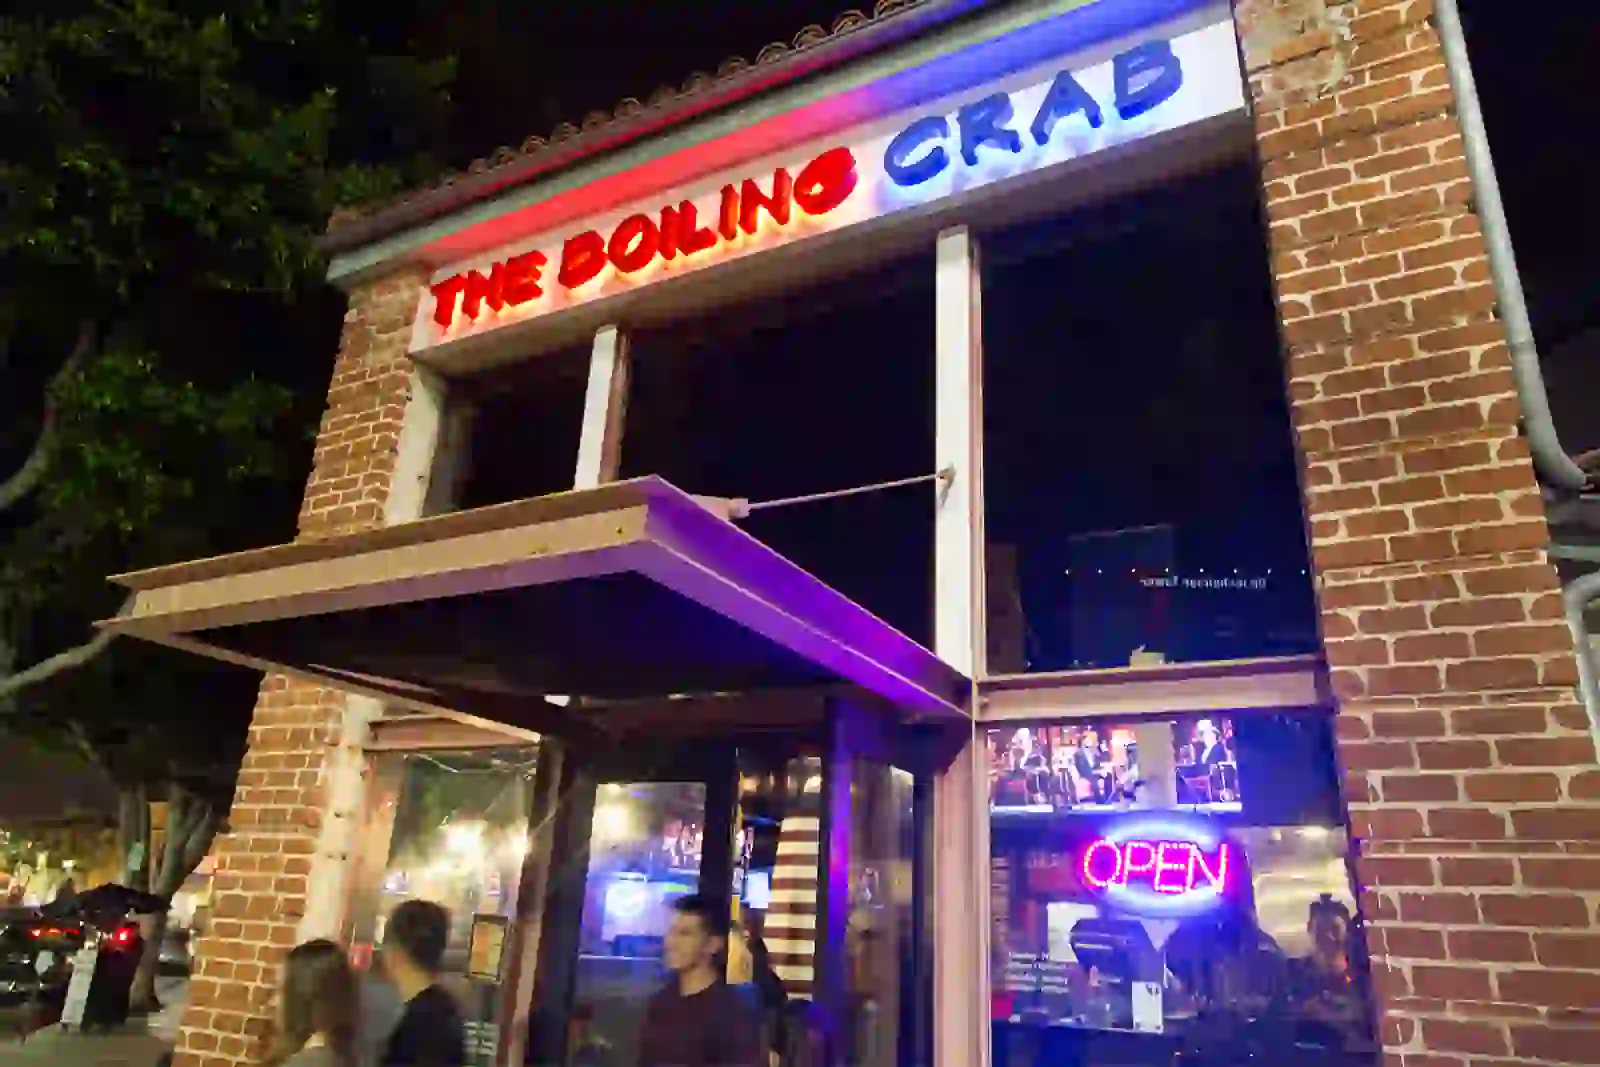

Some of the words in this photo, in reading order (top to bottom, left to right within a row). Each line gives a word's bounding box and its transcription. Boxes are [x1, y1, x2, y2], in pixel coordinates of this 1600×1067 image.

[431, 250, 548, 330] THE
[559, 147, 858, 289] BOILING
[884, 40, 1183, 186] CRAB
[1083, 838, 1229, 894] OPEN
